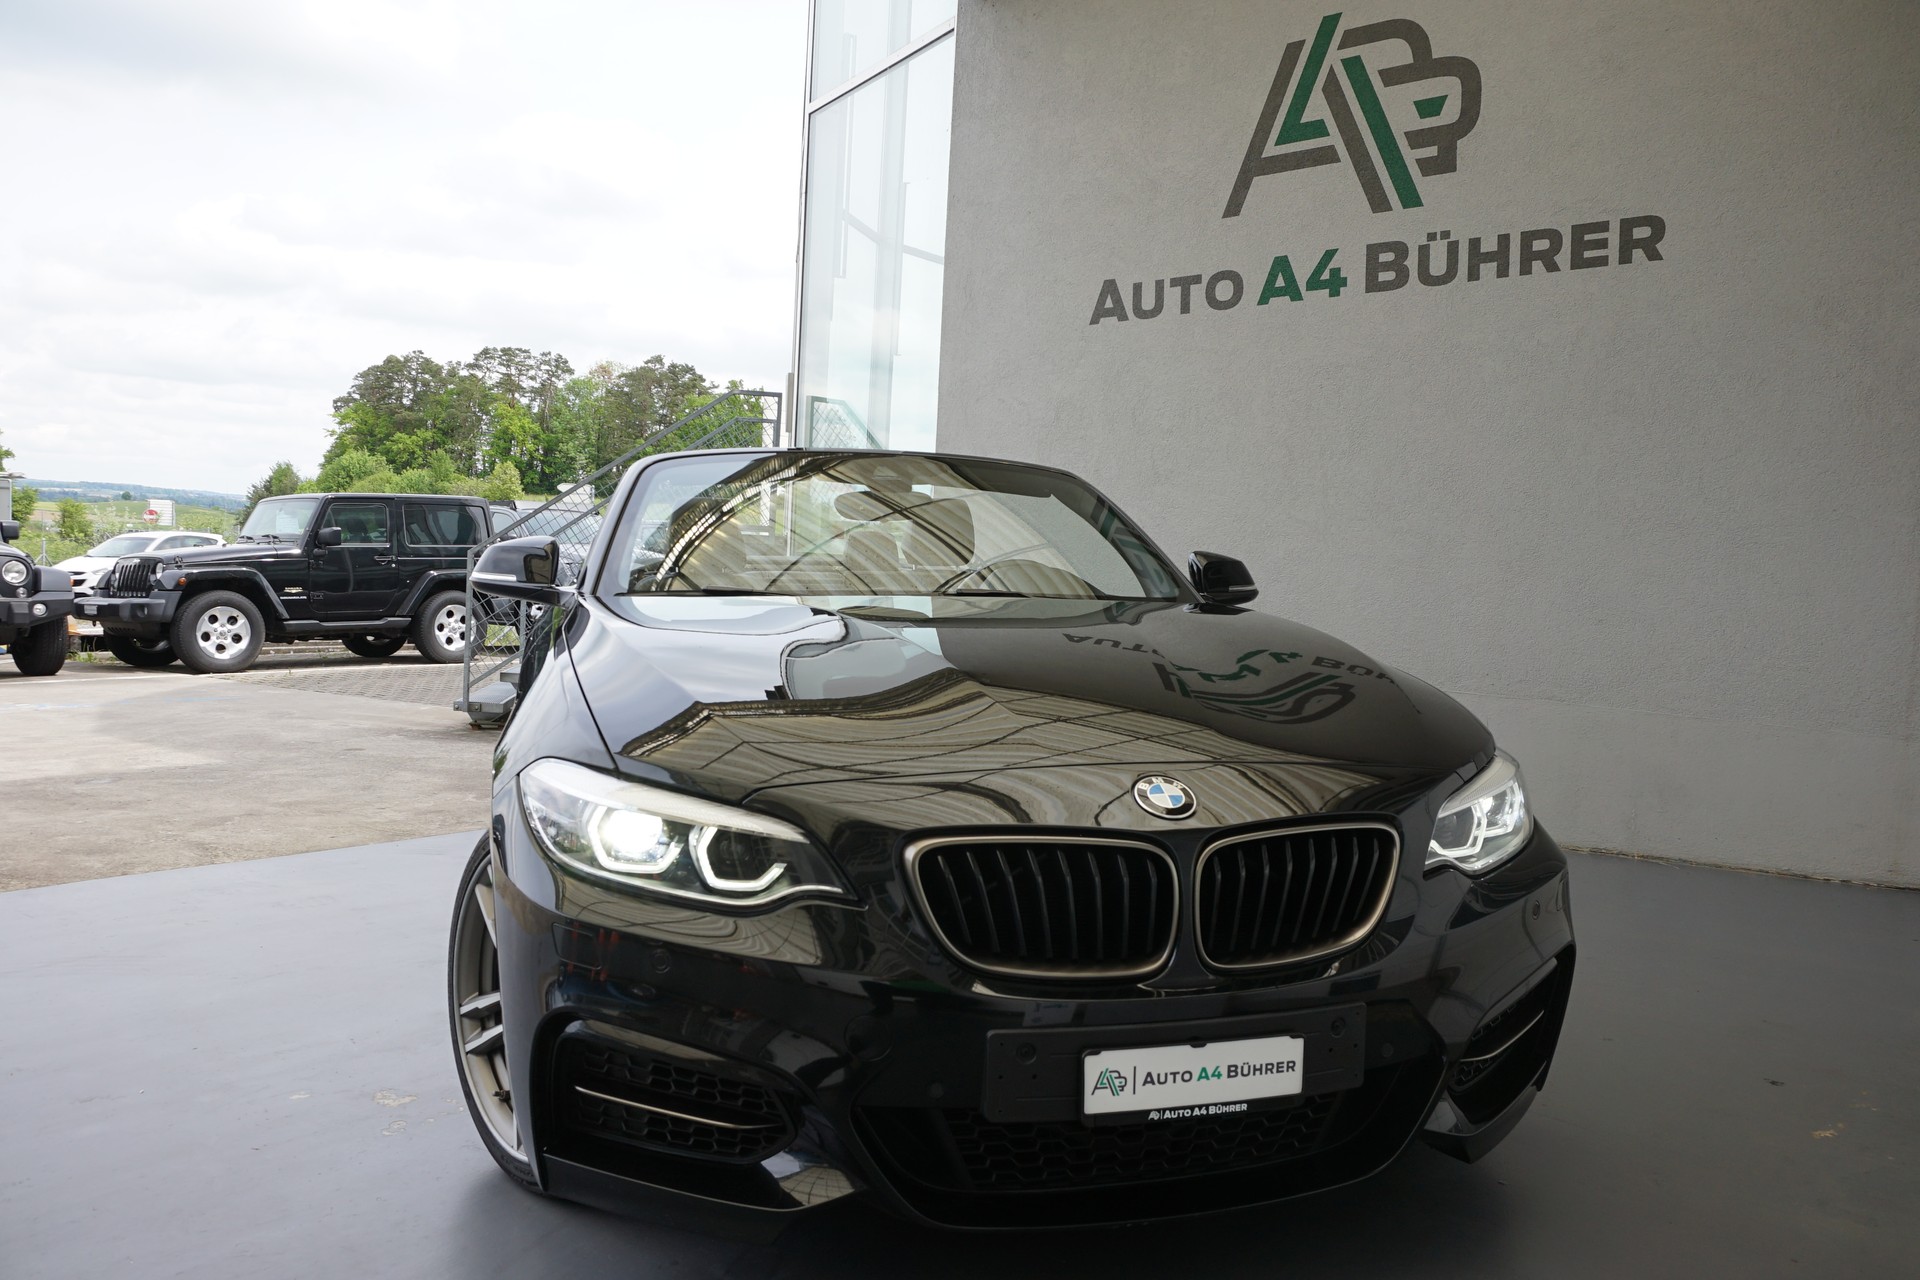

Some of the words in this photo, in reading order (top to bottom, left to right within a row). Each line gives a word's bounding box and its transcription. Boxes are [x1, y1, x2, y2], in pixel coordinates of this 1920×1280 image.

[1089, 269, 1245, 326] AUTO
[1256, 247, 1348, 306] A4
[1364, 214, 1667, 294] BÜHRER
[1142, 1070, 1193, 1087] AUTO
[1196, 1065, 1223, 1082] A4
[1226, 1060, 1297, 1079] BÜHRER
[1163, 1109, 1192, 1119] AUTO
[1192, 1106, 1207, 1117] A4
[1208, 1103, 1248, 1115] BÜHRER
